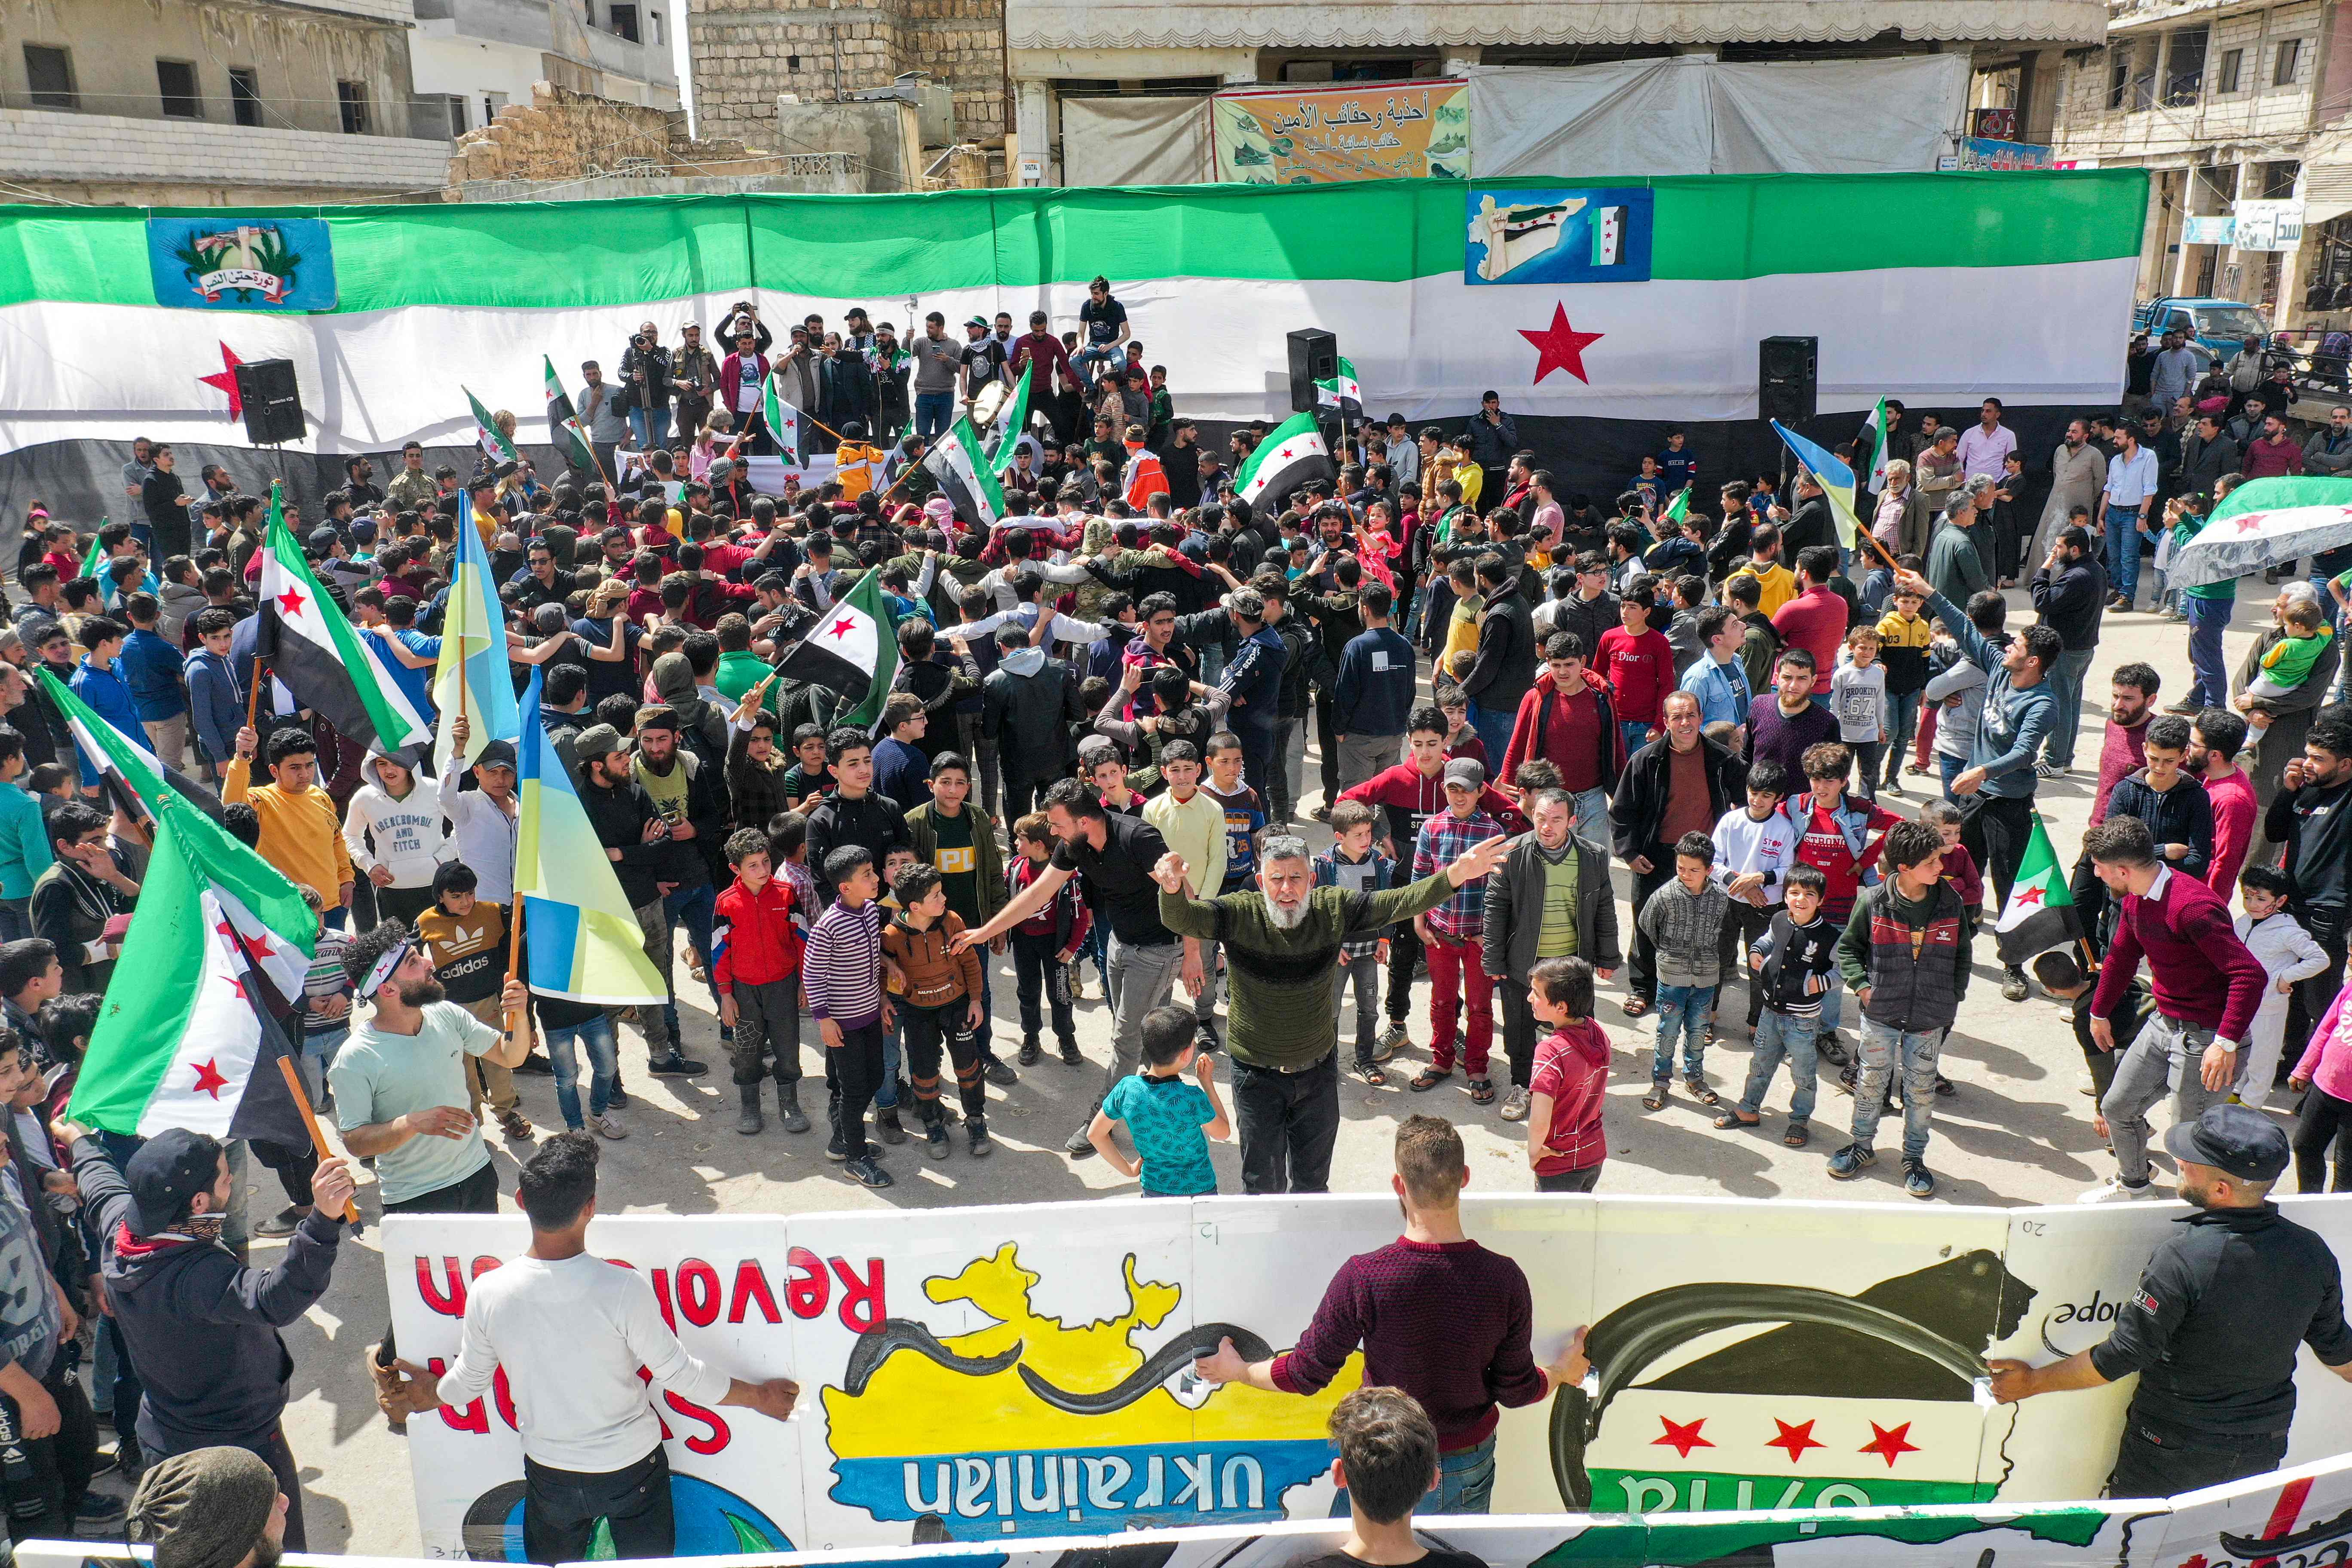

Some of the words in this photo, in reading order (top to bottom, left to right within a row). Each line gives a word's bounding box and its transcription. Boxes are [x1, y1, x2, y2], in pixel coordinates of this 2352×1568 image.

[1387, 96, 1429, 123] أحذية
[1273, 103, 1318, 135] الأمين
[1371, 135, 1401, 149] حقائب
[206, 272, 226, 292] النصر
[253, 272, 273, 288] ثورة
[1618, 651, 1639, 662] Dior
[1850, 696, 1874, 716] 67
[395, 827, 413, 839] AND
[393, 839, 421, 852] FITCH
[441, 956, 489, 980] adidas
[934, 983, 951, 993] LAUREN
